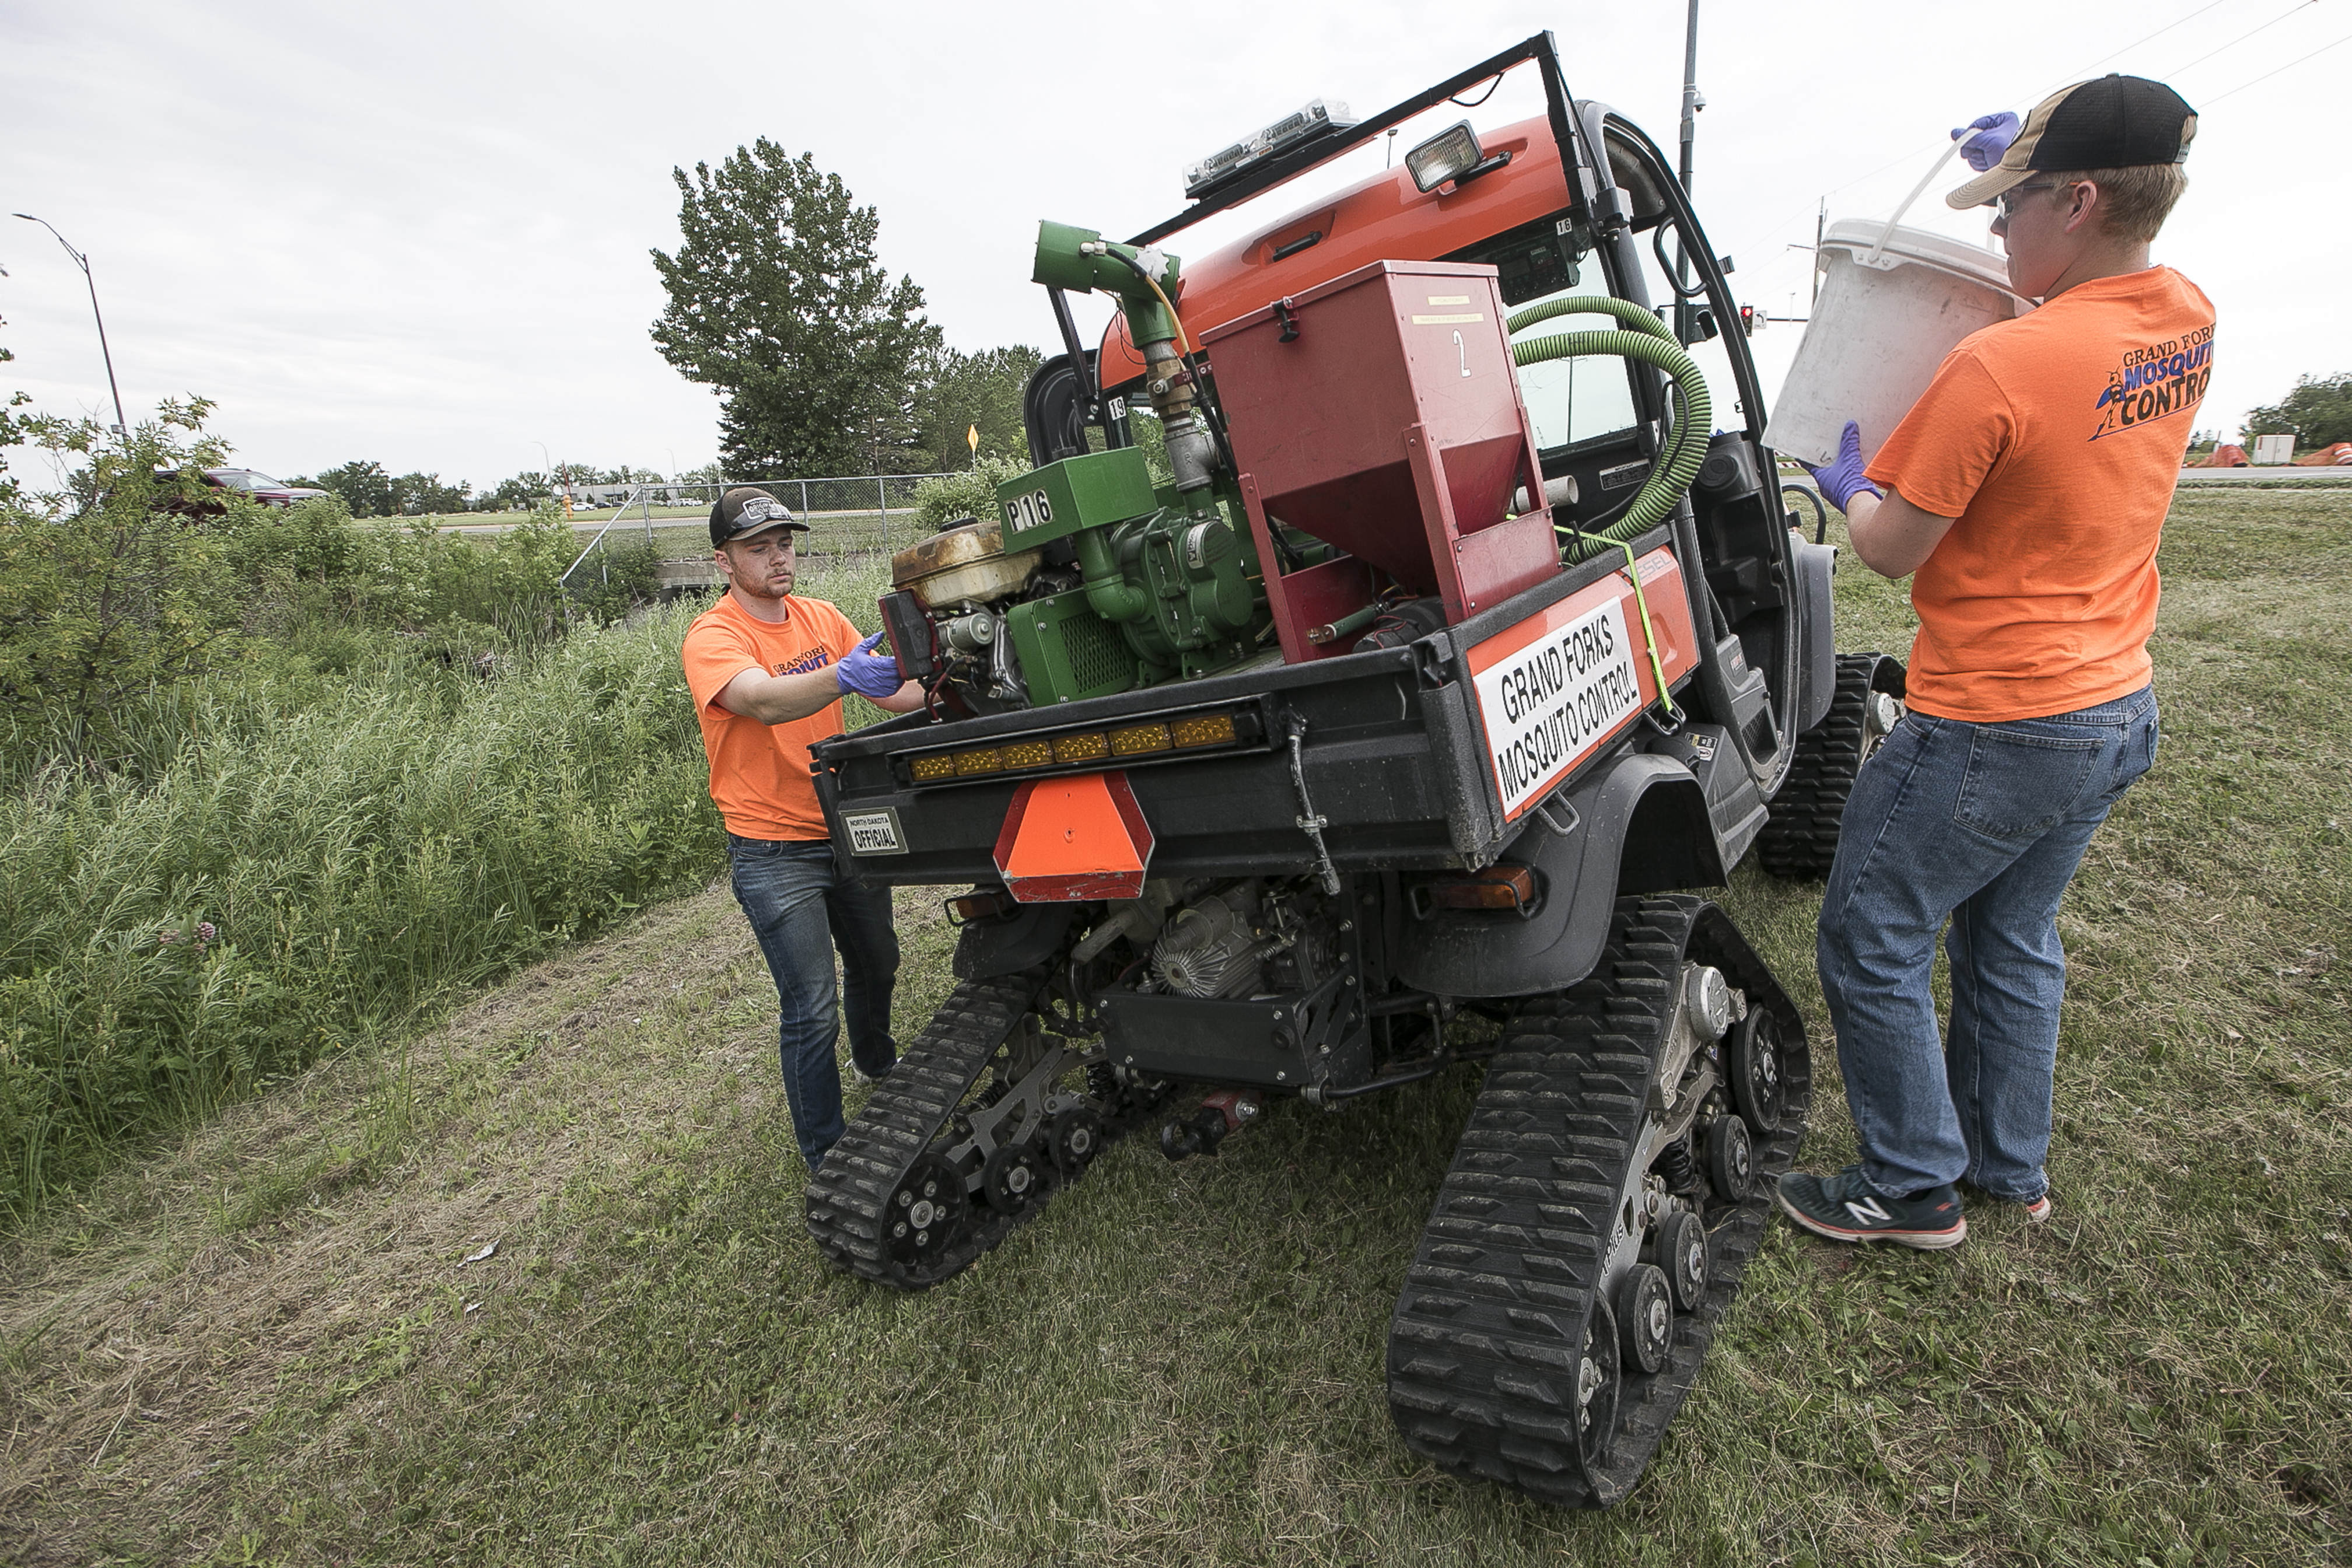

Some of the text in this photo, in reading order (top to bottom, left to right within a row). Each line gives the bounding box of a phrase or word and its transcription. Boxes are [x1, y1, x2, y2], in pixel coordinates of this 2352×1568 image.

[1558, 219, 1571, 233] 16
[1452, 328, 1472, 378] 2
[2123, 340, 2178, 367] GRAND
[2123, 340, 2214, 391] MOSQUIT
[1110, 398, 1124, 418] 19
[1006, 490, 1051, 532] P16
[1500, 614, 1615, 725] GRAND FORKS
[1497, 661, 1638, 803] MOSQUITO CONTROL
[849, 817, 889, 827] NORTH DAKOTA
[854, 828, 897, 849] OFFICIAL
